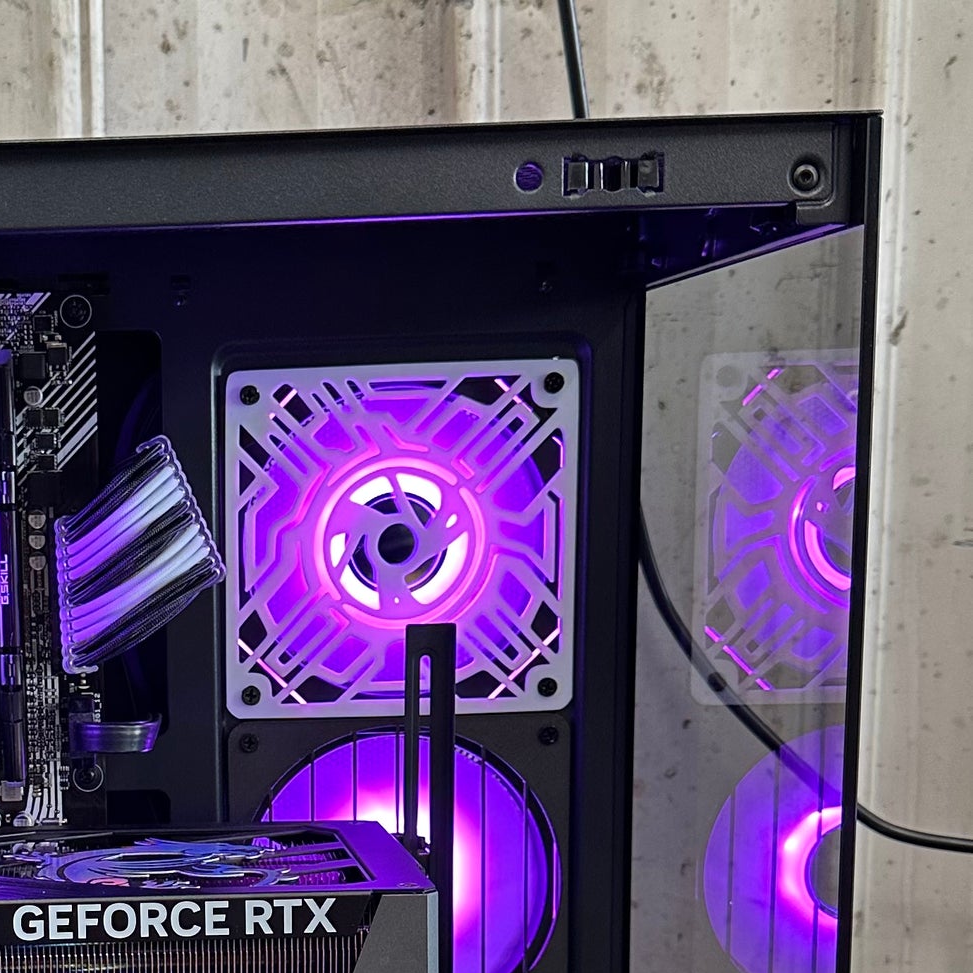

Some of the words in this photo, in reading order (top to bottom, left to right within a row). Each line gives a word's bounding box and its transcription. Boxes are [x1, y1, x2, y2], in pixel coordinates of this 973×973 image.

[0, 553, 10, 605] G.SKILL
[13, 901, 230, 941] GEFORCE
[245, 898, 338, 935] RTX
